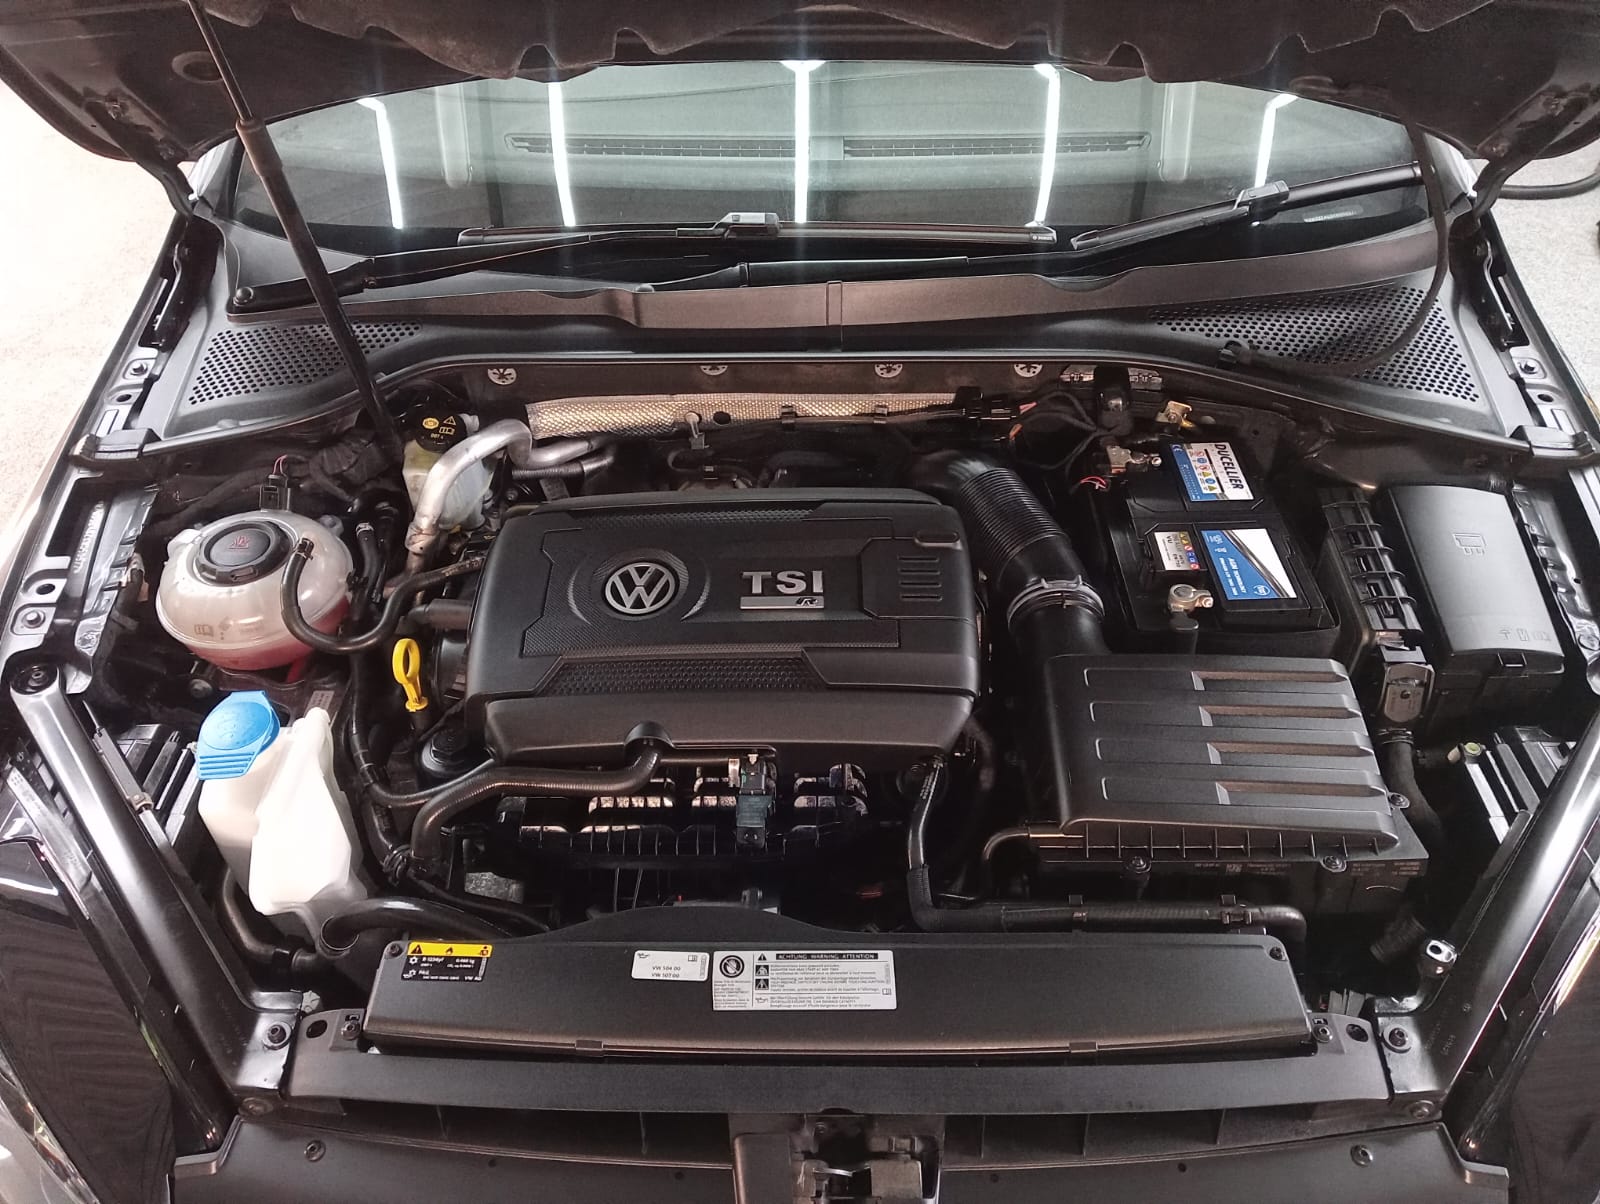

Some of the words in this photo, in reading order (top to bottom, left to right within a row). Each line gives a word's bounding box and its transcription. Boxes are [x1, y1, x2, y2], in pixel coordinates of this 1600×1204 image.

[1215, 443, 1244, 490] DUCELLIER
[604, 562, 676, 615] VW
[742, 570, 824, 594] TSI
